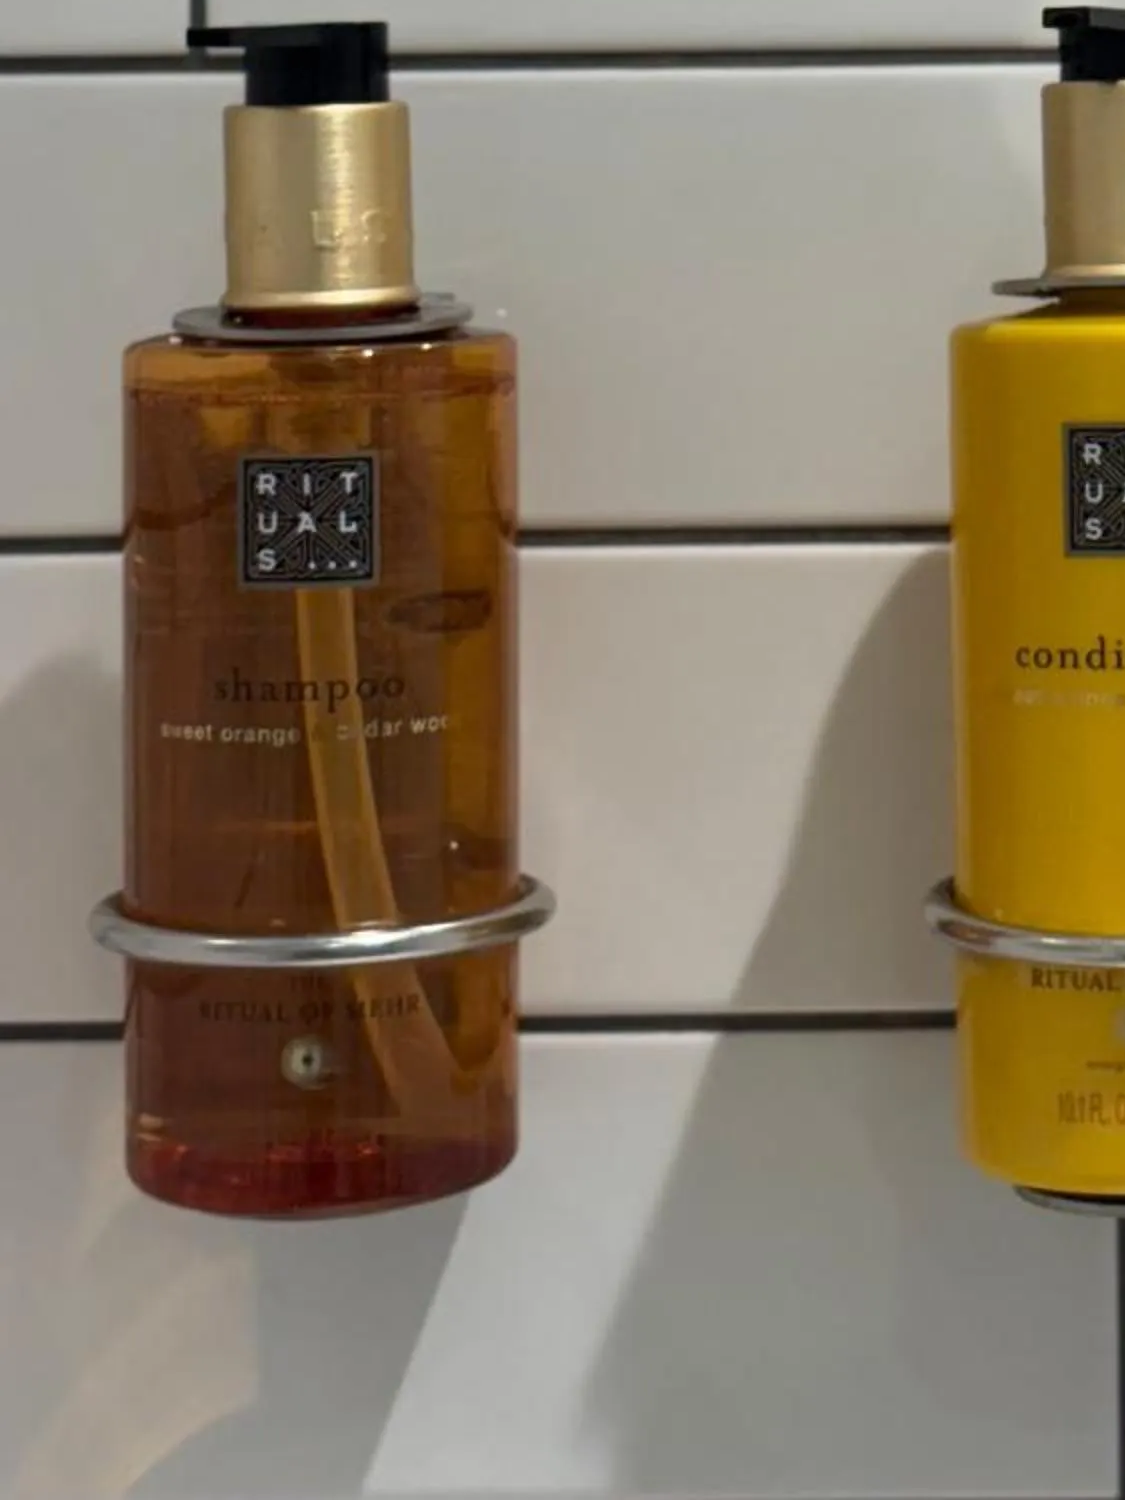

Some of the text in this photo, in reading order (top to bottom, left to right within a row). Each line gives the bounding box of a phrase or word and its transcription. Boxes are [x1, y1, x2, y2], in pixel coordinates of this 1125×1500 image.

[213, 667, 406, 713] shampoo
[160, 720, 213, 742] sweet
[336, 716, 403, 740] cdar
[1031, 967, 1119, 992] RITUAL
